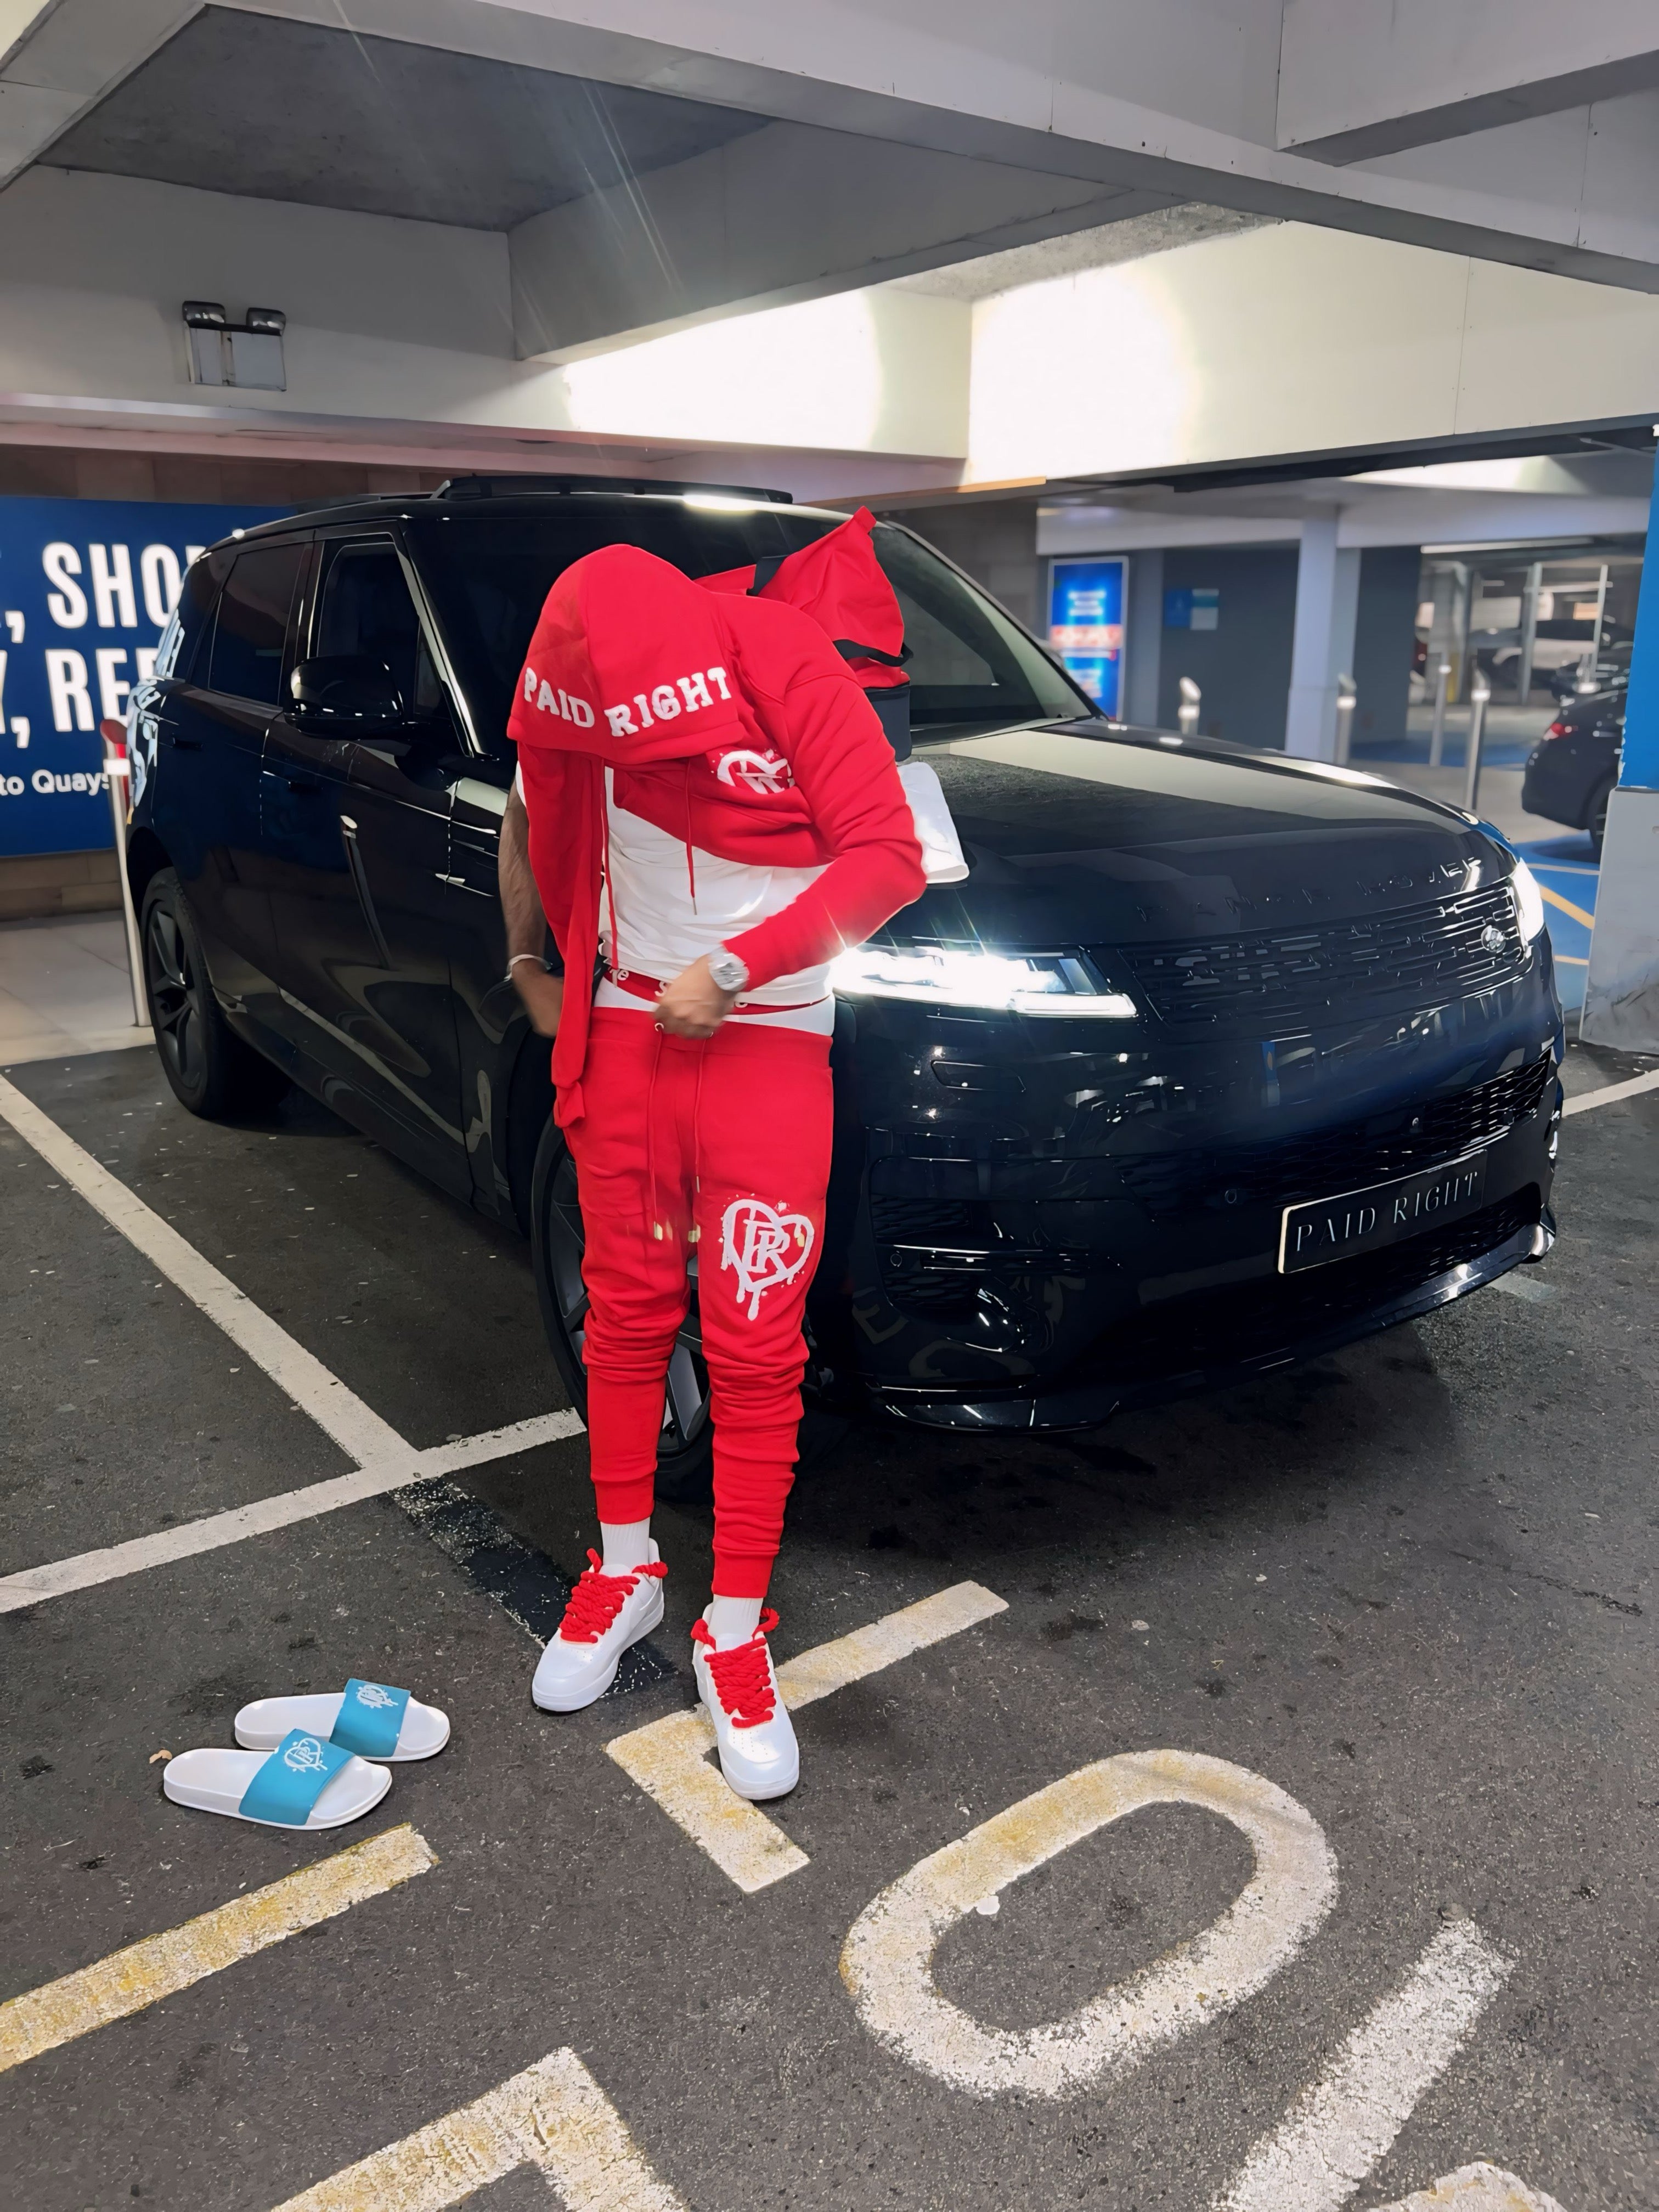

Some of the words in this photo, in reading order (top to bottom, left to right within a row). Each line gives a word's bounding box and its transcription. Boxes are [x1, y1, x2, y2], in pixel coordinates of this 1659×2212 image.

[42, 541, 205, 629] SHO
[524, 667, 595, 728] PAID
[604, 667, 731, 737] RIGHT
[1296, 1207, 1375, 1252] PAID
[1393, 1171, 1477, 1224] RIGHT
